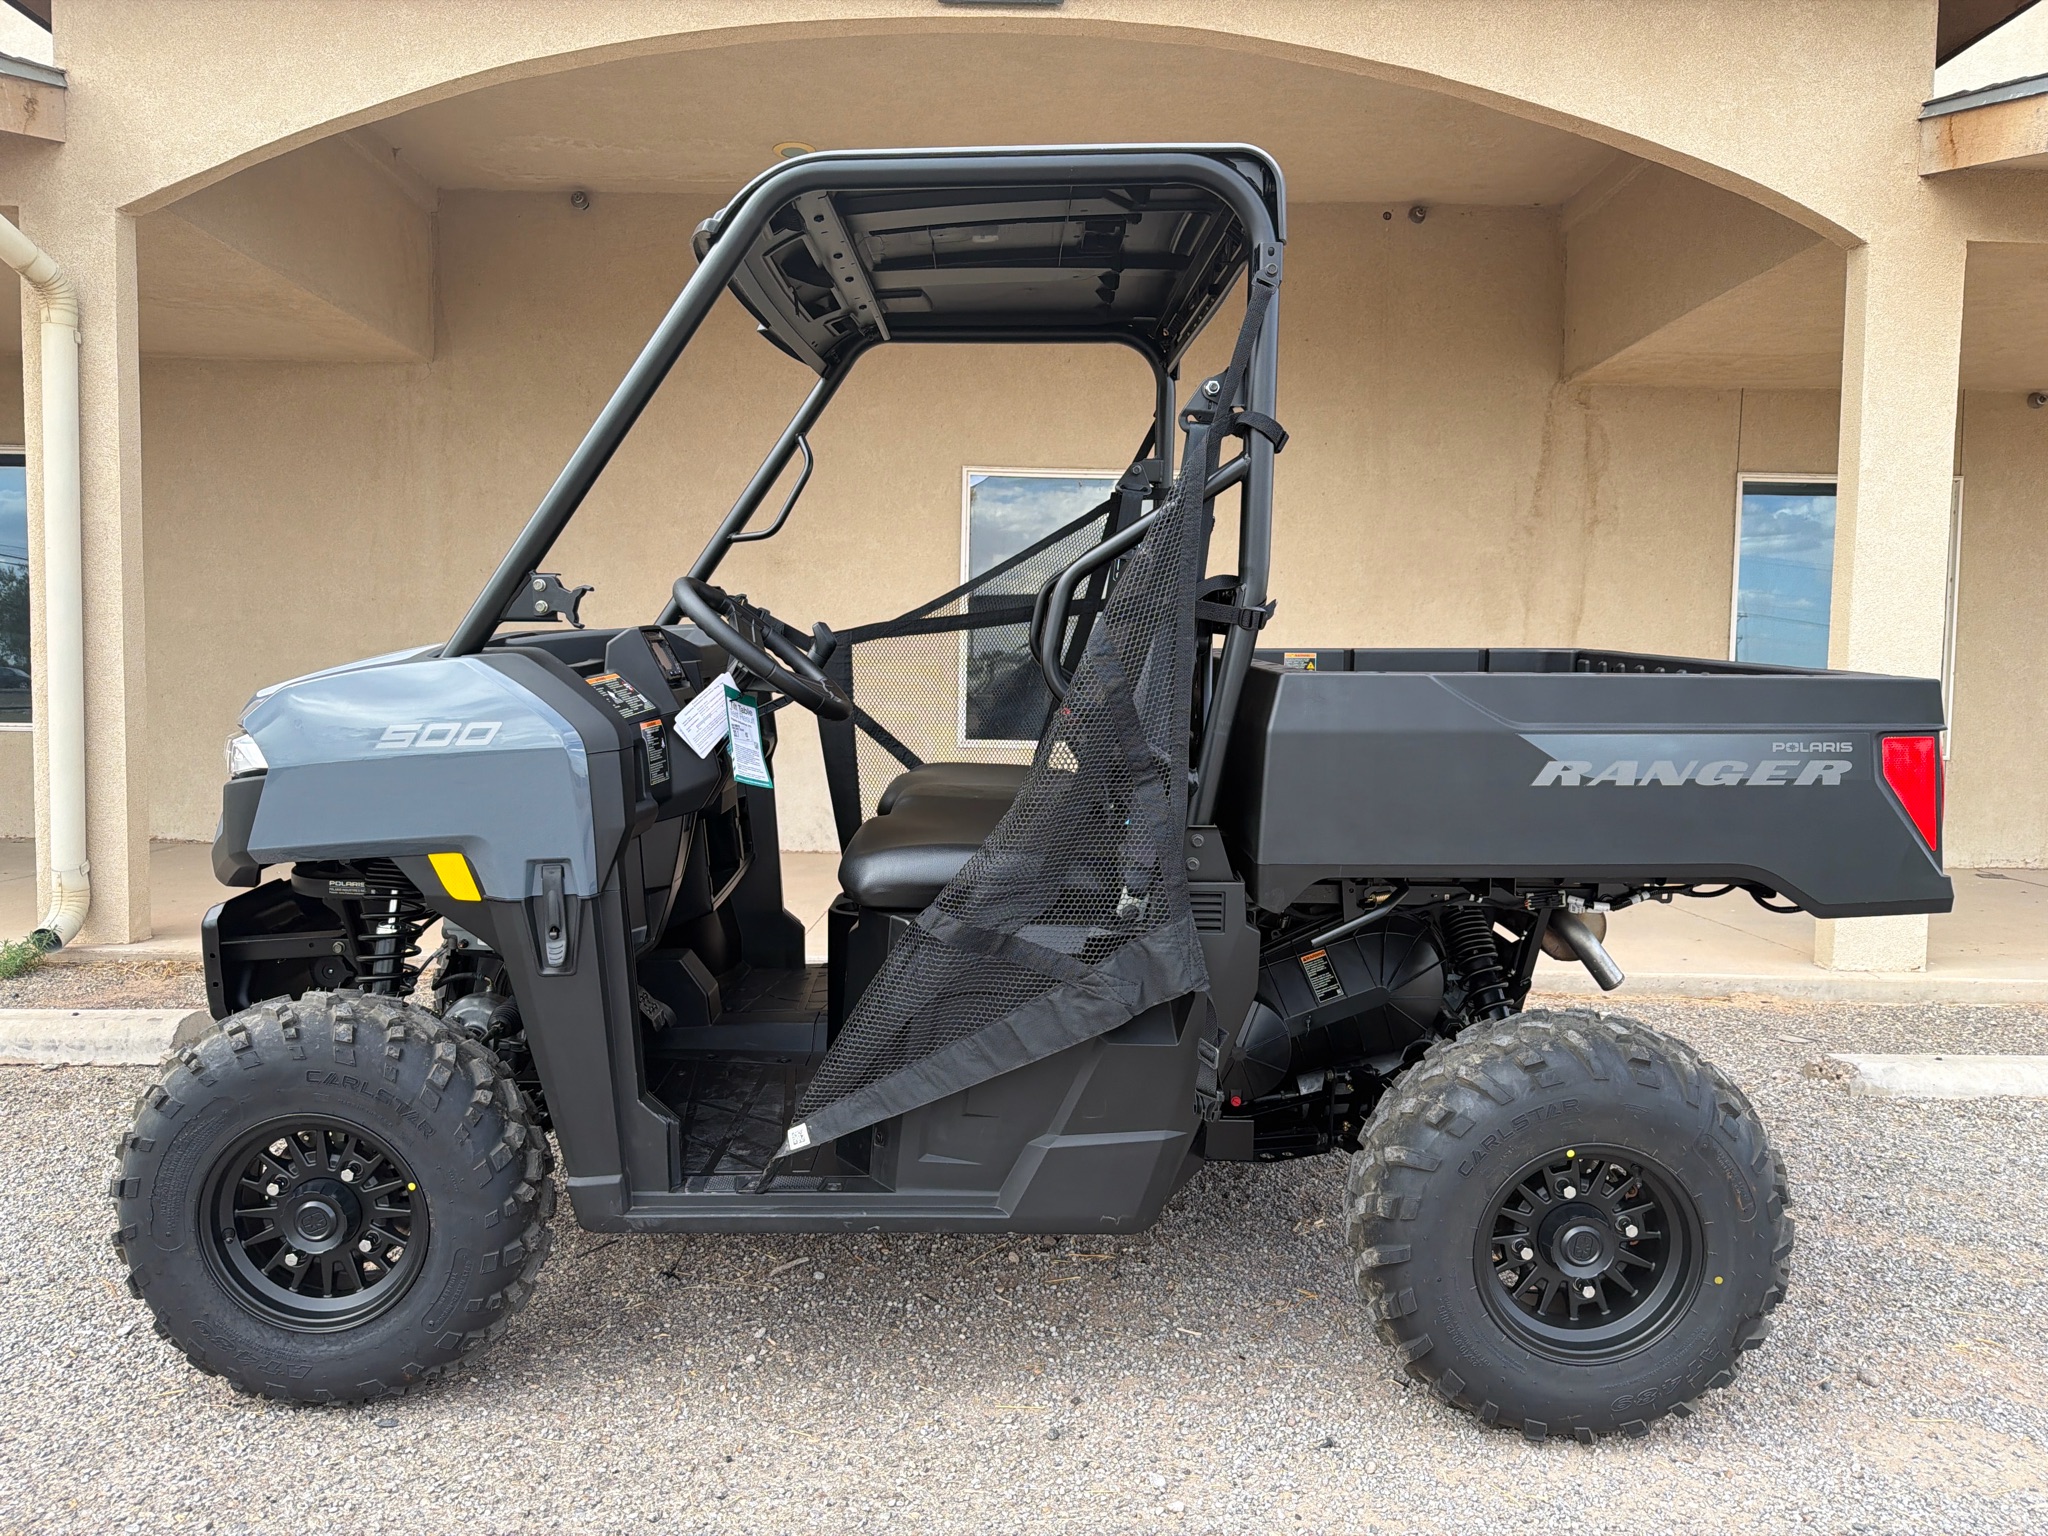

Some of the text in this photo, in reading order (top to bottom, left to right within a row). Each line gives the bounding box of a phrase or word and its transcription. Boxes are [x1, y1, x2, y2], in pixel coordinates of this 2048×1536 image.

[738, 704, 753, 716] Table
[376, 722, 502, 749] 500
[1772, 742, 1853, 753] POLARIS
[1531, 760, 1852, 787] RANGER
[304, 1069, 437, 1140] CARLSTAR
[1457, 1098, 1580, 1178] CARLSTAR
